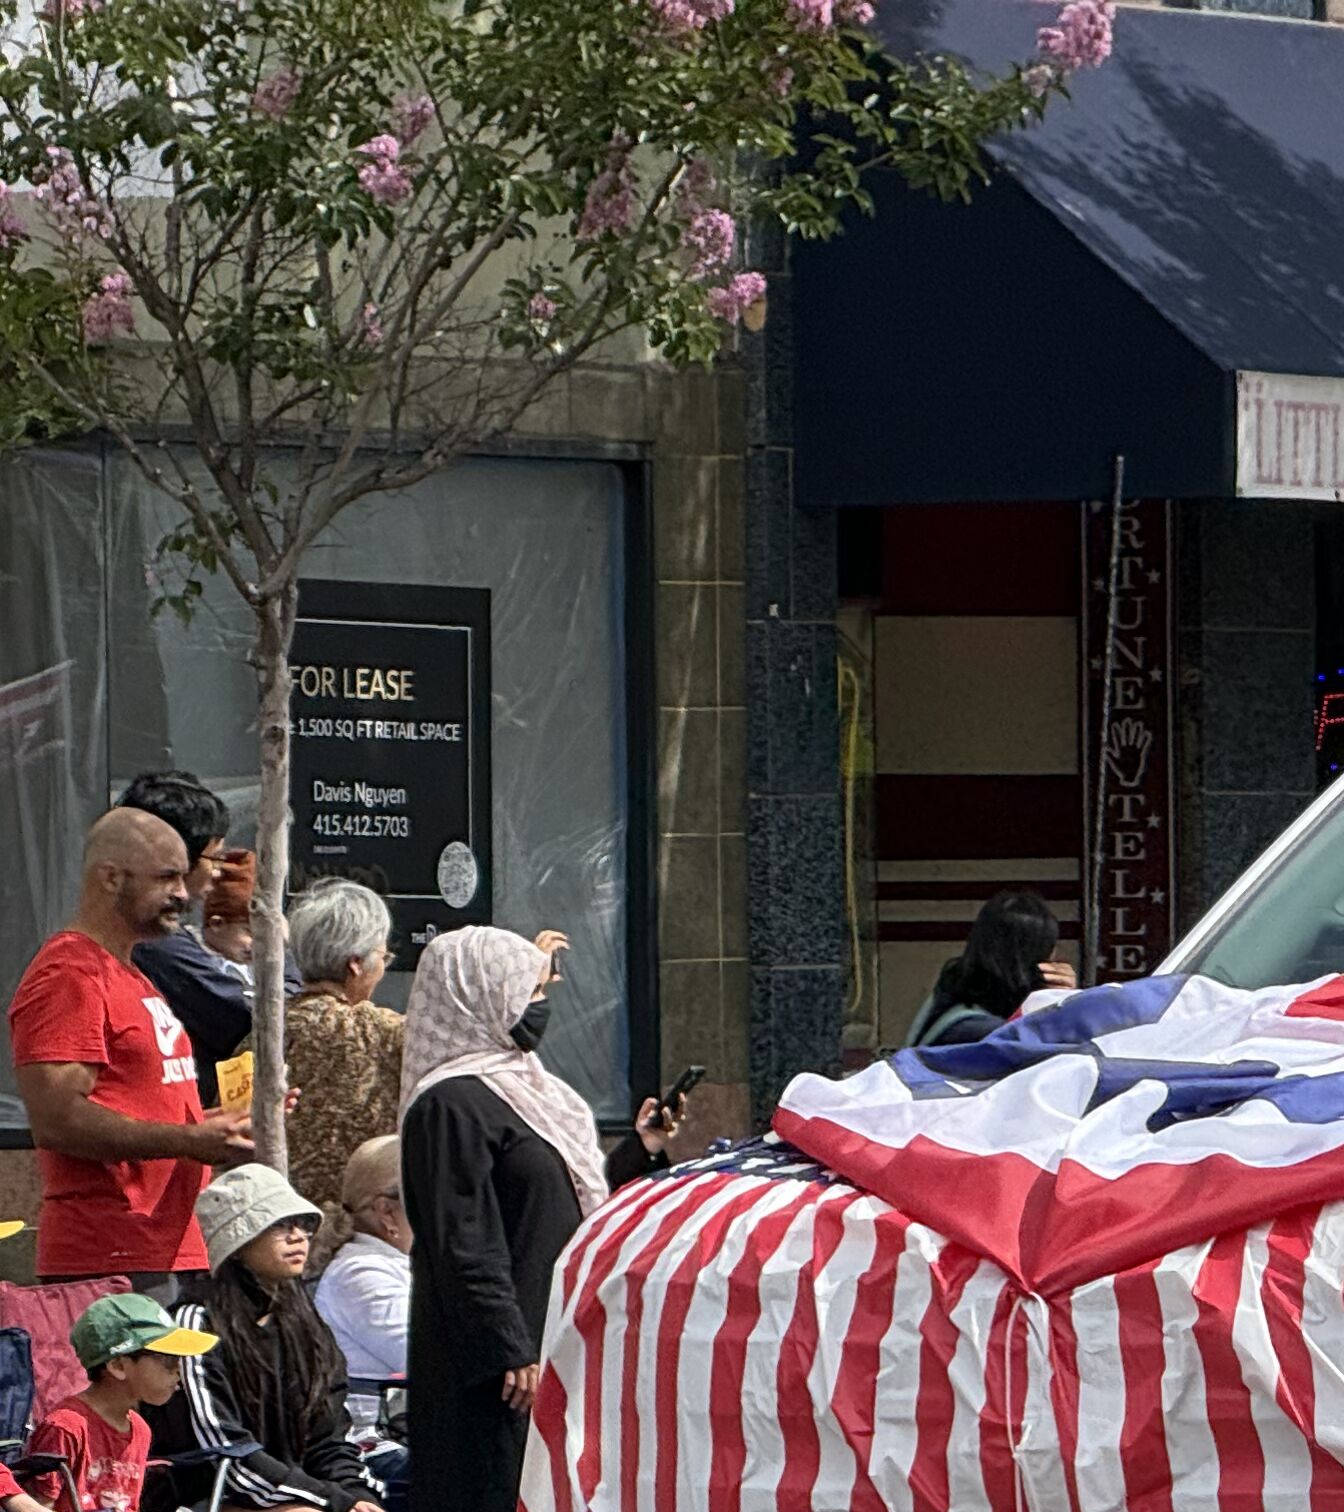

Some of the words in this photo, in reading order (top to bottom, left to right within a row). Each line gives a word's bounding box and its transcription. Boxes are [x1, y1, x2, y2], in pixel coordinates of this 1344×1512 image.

[288, 665, 337, 698] FOR
[342, 667, 416, 701] LEASE
[334, 720, 354, 742] SQ
[356, 720, 374, 740] FT
[375, 721, 418, 742] RETAIL
[419, 723, 462, 742] SPACE
[313, 779, 351, 803] Davis
[353, 781, 407, 808] Nguyen
[313, 813, 410, 838] 415.412.5703
